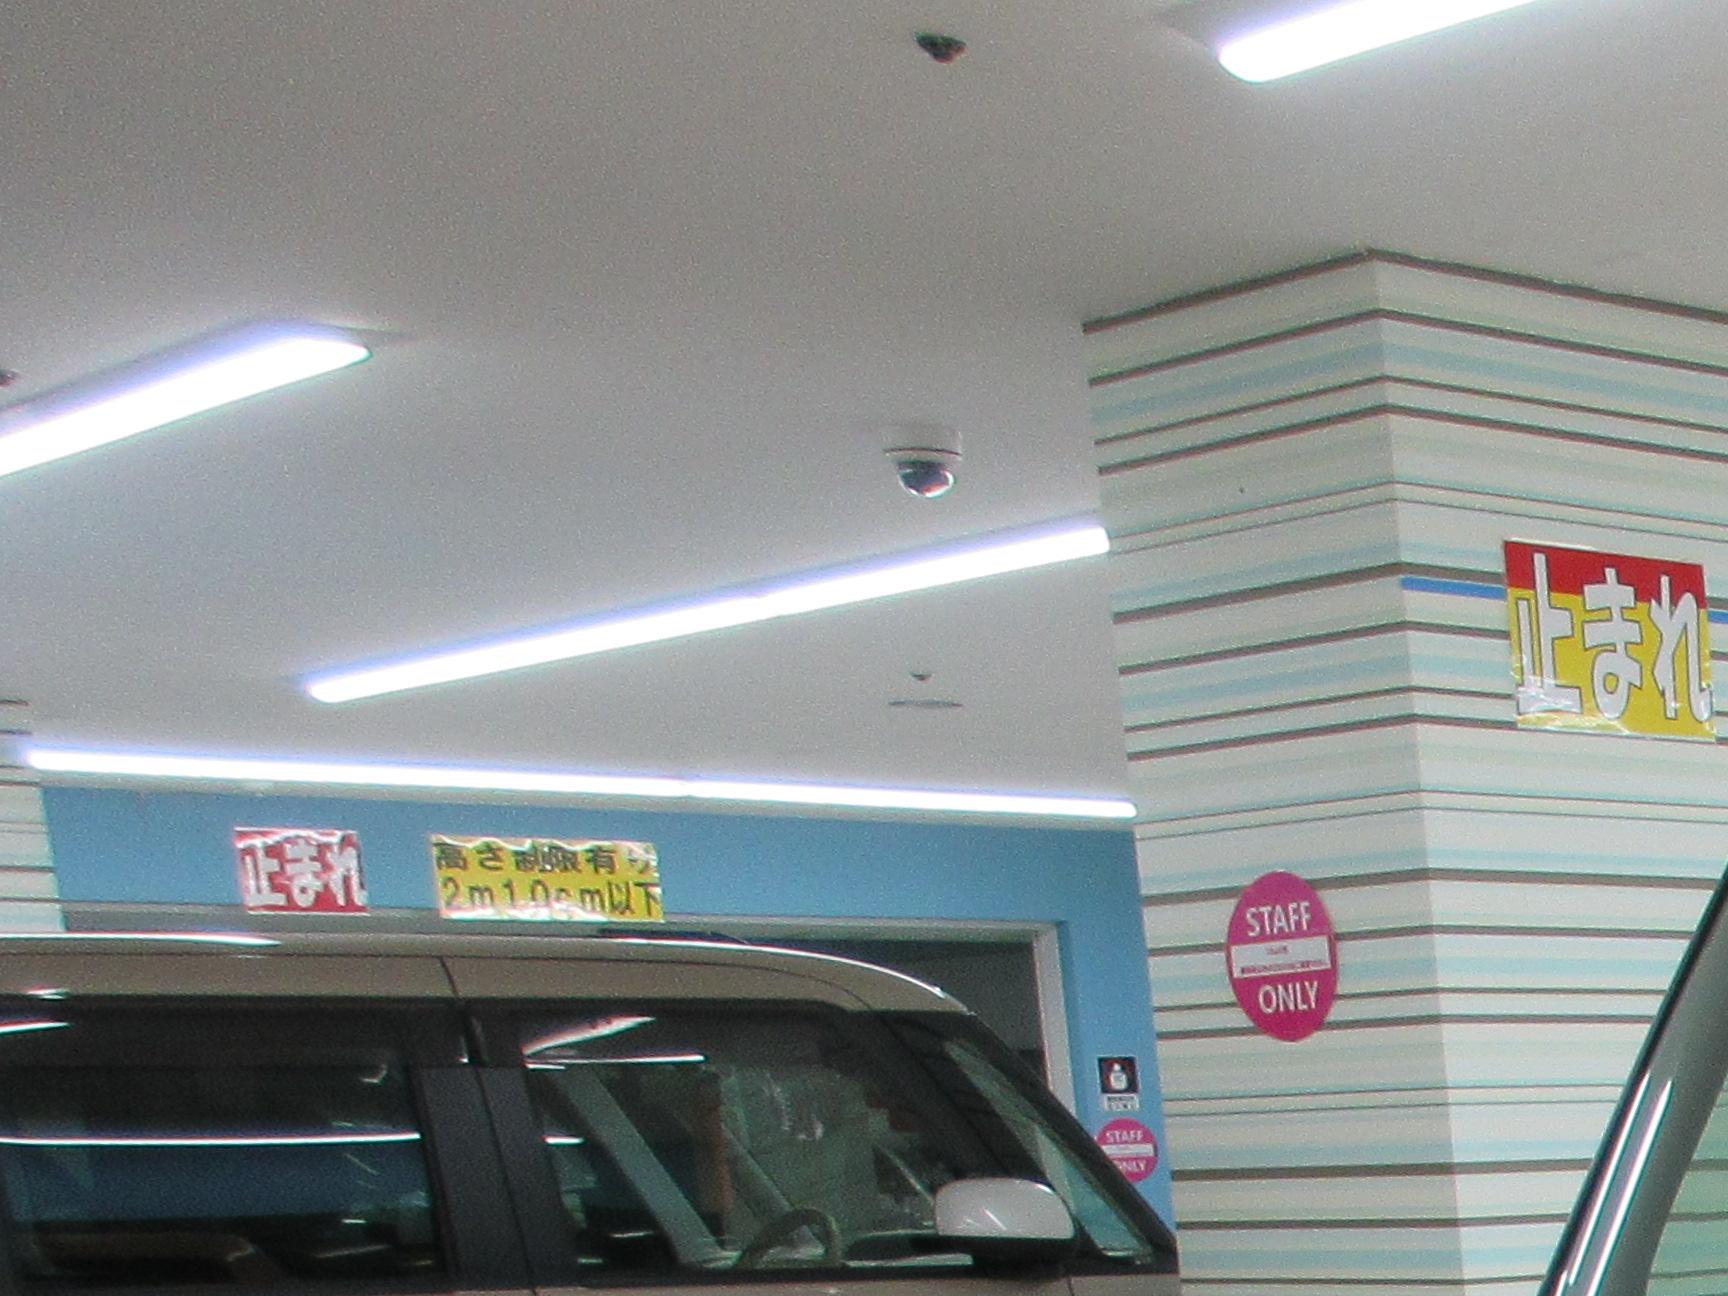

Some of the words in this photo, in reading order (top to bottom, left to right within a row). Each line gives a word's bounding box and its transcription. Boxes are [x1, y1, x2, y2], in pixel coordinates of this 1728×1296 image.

[1516, 552, 1713, 722] 止まれ
[243, 837, 367, 908] 止まれ
[1245, 899, 1312, 938] STAFF
[1257, 980, 1318, 1015] ONLY
[1106, 1129, 1143, 1143] STAFF
[1114, 1160, 1147, 1171] NLY
